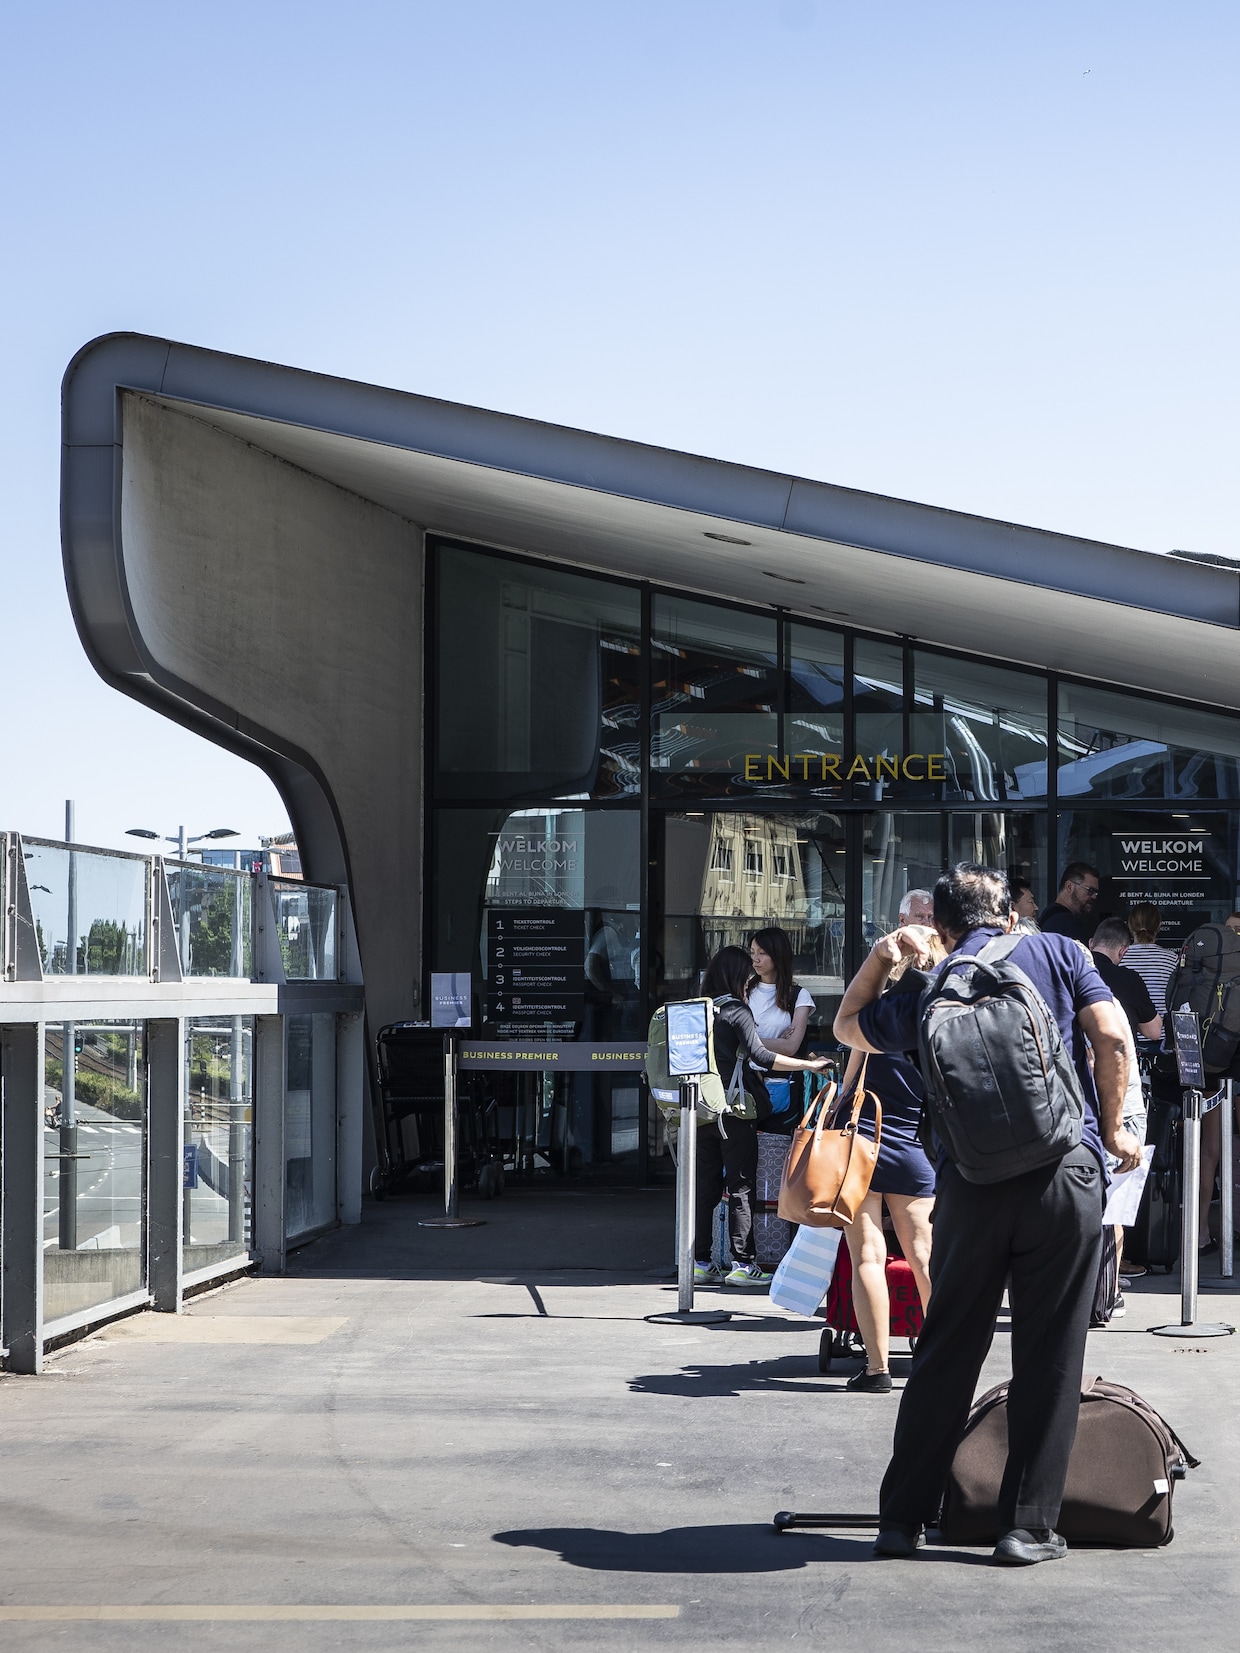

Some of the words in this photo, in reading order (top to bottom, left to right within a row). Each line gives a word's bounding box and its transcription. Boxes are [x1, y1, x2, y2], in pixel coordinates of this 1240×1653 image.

[744, 754, 947, 781] ENTRANCE
[498, 840, 577, 853] WELKOM
[1121, 840, 1203, 854] WELKOM
[498, 859, 577, 871] WELCOME
[1121, 860, 1203, 872] WELCOME
[495, 920, 505, 930] 1
[495, 947, 505, 957] 2
[495, 974, 505, 985] 3
[495, 1002, 505, 1012] 4
[671, 1033, 703, 1041] BUSINESS
[463, 1052, 513, 1060] BUSINESS
